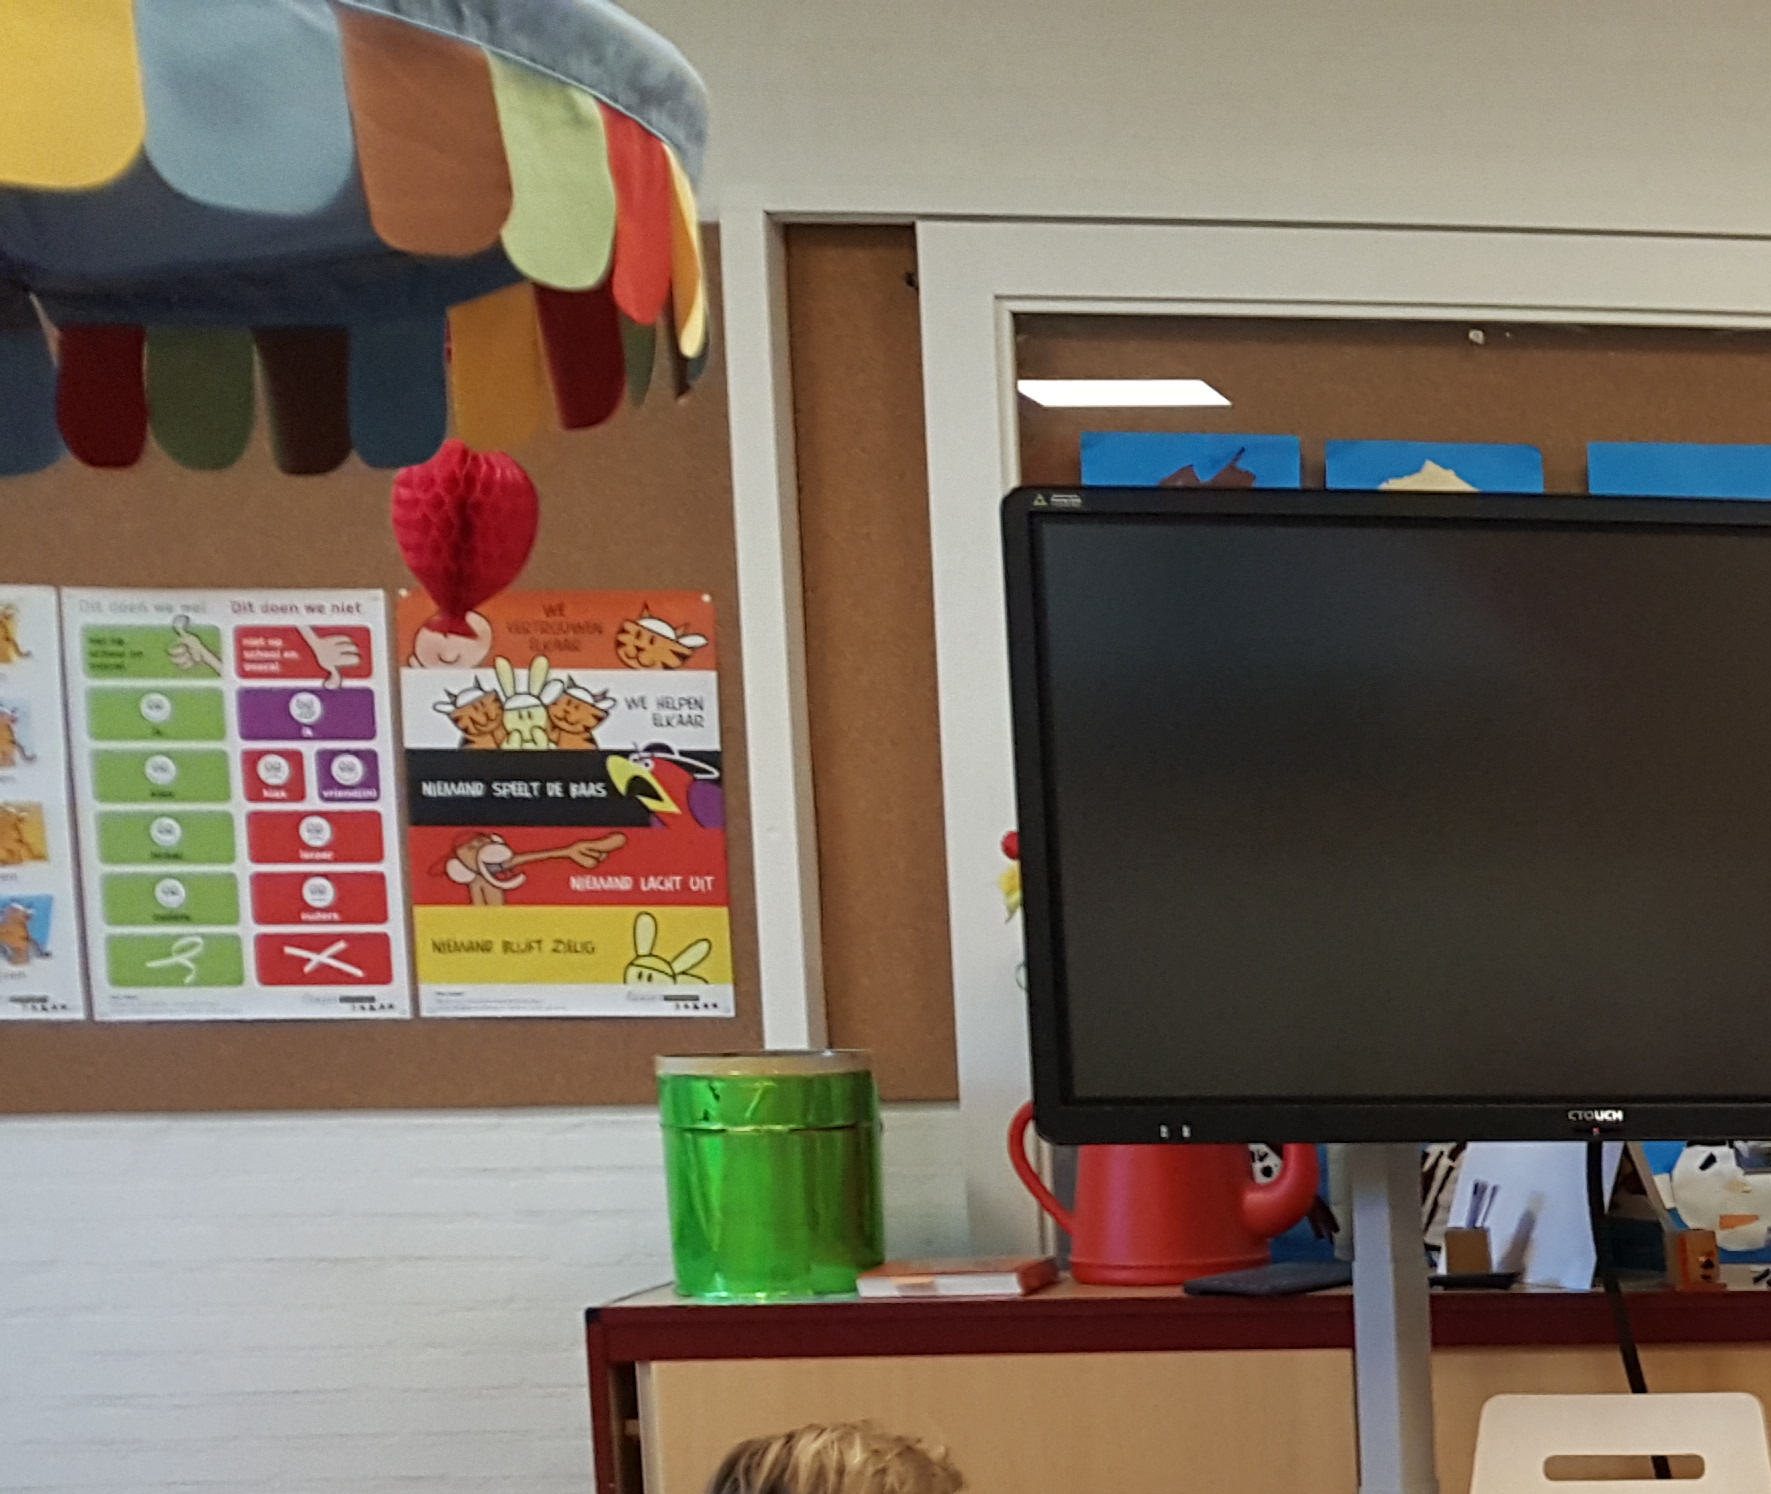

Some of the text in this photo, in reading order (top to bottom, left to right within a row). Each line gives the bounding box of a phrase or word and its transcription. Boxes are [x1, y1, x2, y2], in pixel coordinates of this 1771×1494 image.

[624, 696, 705, 711] WE HELPEN
[652, 713, 705, 728] ELKAAR
[421, 780, 607, 799] NIEMAND SPEELT DE BAAS
[570, 875, 715, 892] NIEMAND LACHT UIT
[432, 938, 493, 954] NIEMAND
[1567, 1109, 1624, 1121] CTOUCH
